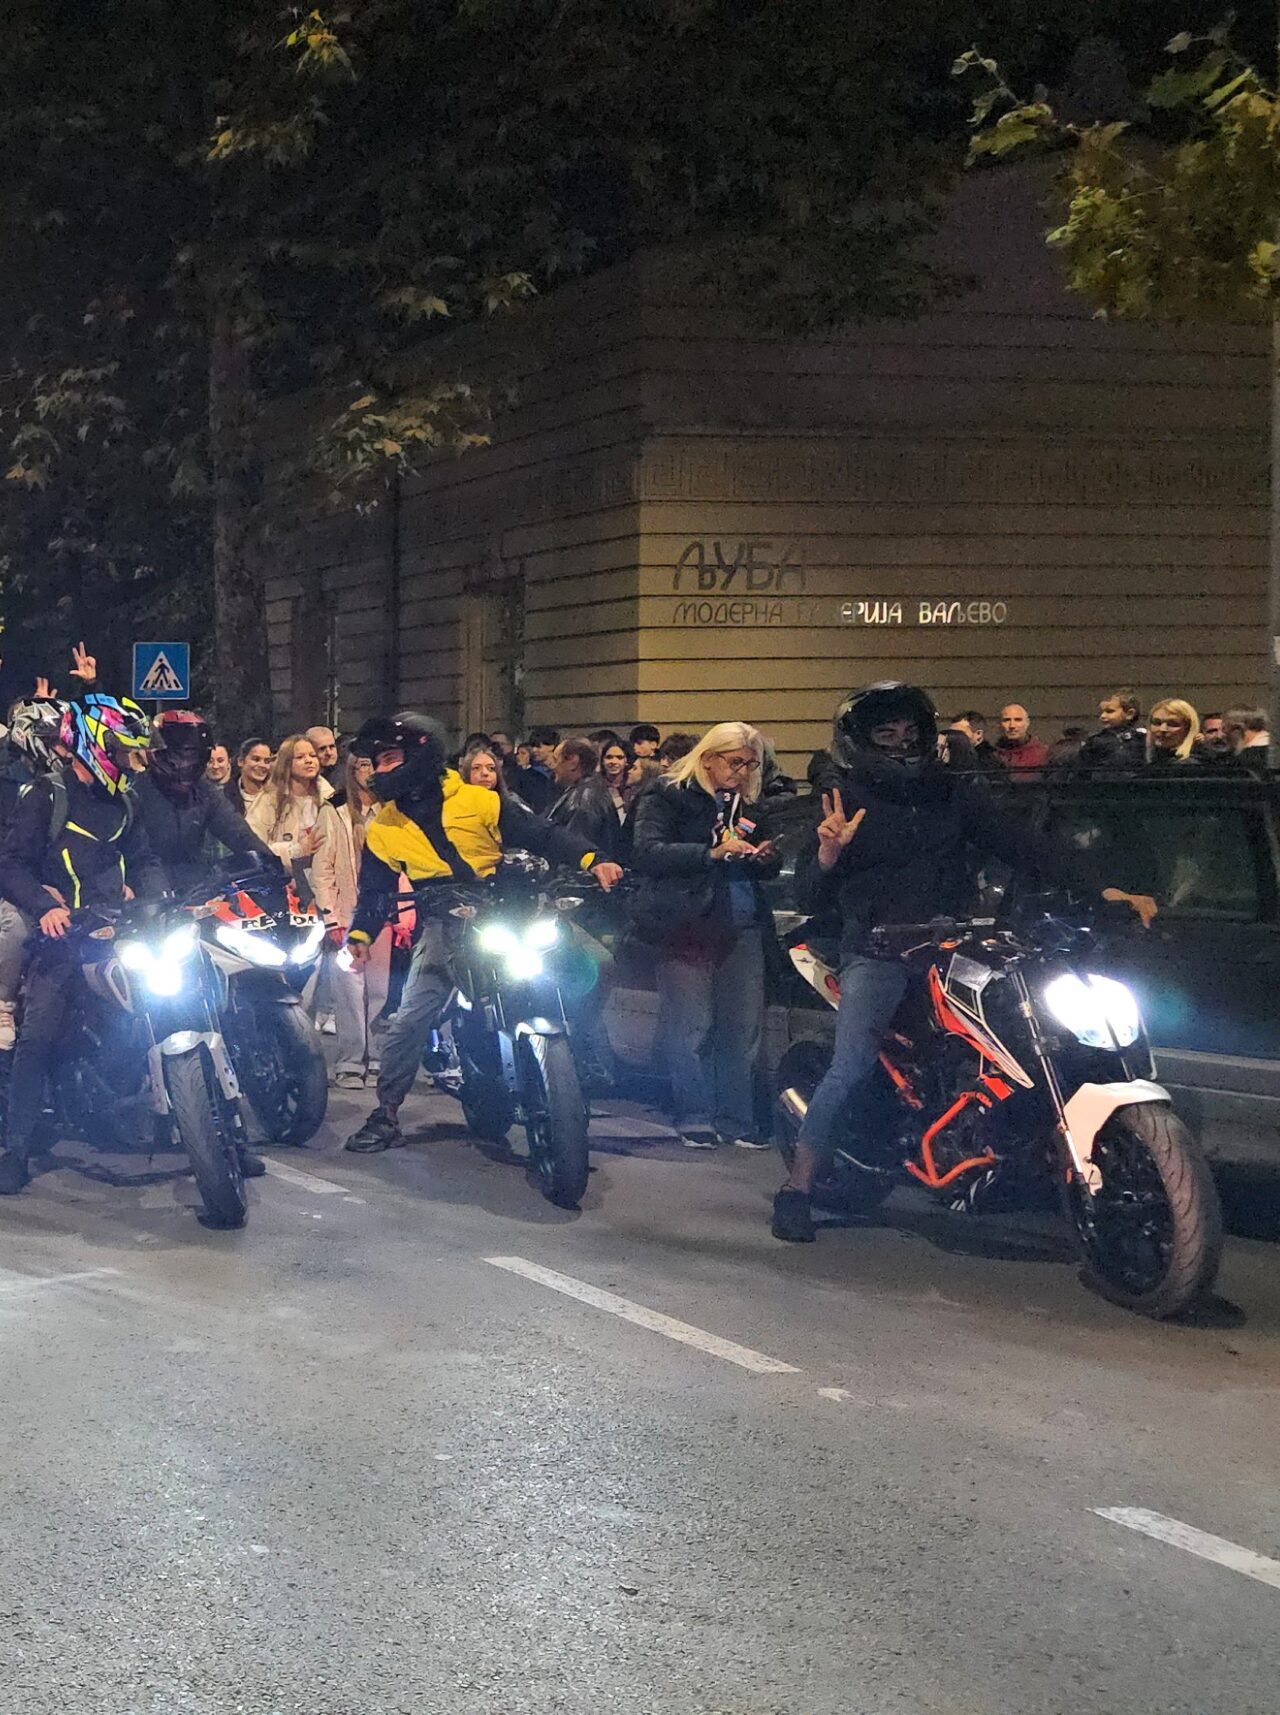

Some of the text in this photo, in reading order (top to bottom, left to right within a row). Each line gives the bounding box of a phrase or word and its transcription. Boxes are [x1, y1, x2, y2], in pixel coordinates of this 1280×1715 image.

[673, 541, 807, 591] ЉУБА
[672, 601, 783, 625] МОДЕРНА
[918, 601, 1008, 624] ВАЉЕВО
